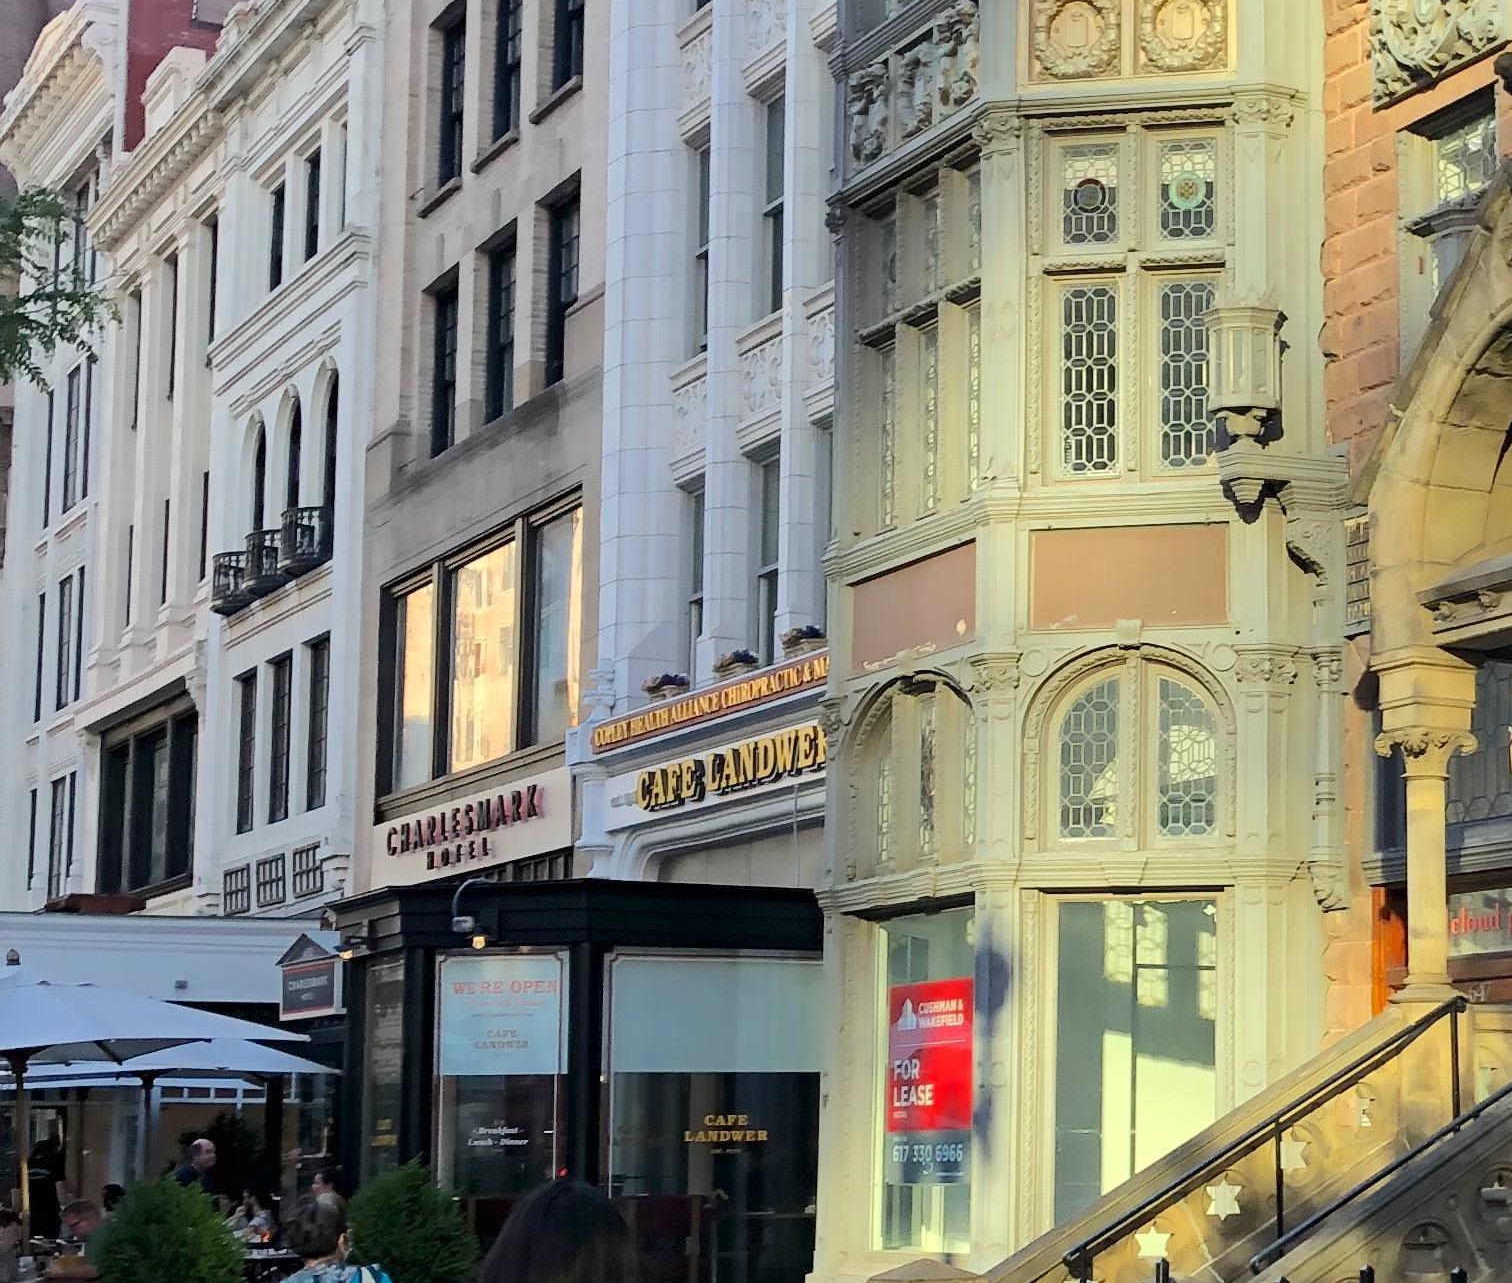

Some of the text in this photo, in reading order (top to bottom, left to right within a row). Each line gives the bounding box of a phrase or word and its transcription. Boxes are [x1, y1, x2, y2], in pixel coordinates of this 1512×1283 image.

[594, 720, 630, 747] COPLEY
[630, 705, 669, 737] HEALTH
[669, 692, 720, 724] ALLIANCE
[721, 665, 801, 708] CHIROPRACTIC
[803, 661, 811, 683] &
[636, 759, 697, 811] CAFE
[386, 784, 538, 856] CHARLESMARK
[426, 837, 490, 870] HOTEL
[1450, 902, 1500, 935] cloud
[453, 980, 558, 995] WERE OPEN
[918, 999, 956, 1014] CUSHMAN
[918, 1013, 965, 1028] WAKEFIELD
[486, 1029, 518, 1038] CAFE
[894, 1058, 920, 1081] FOR
[893, 1083, 934, 1107] LEASE
[703, 1114, 749, 1126] CAFE
[683, 1130, 768, 1142] LANDWER
[892, 1143, 964, 1163] 617 330 6966
